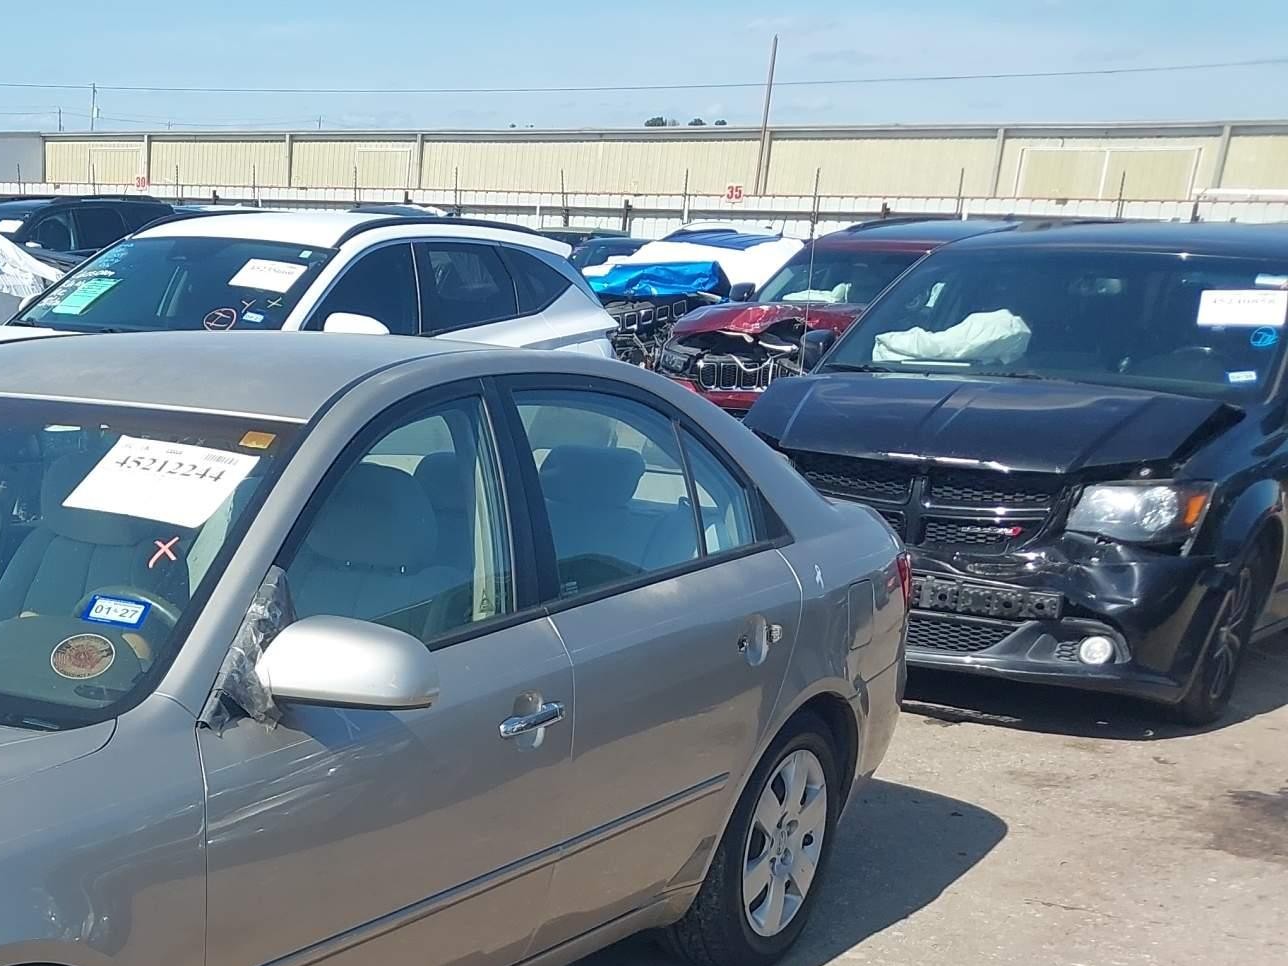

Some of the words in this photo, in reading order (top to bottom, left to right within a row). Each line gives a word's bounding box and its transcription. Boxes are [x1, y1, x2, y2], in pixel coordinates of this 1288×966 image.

[136, 176, 146, 188] 30
[727, 185, 743, 200] 35
[115, 455, 226, 482] 45212244
[94, 604, 112, 616] 01
[119, 607, 139, 619] 27
